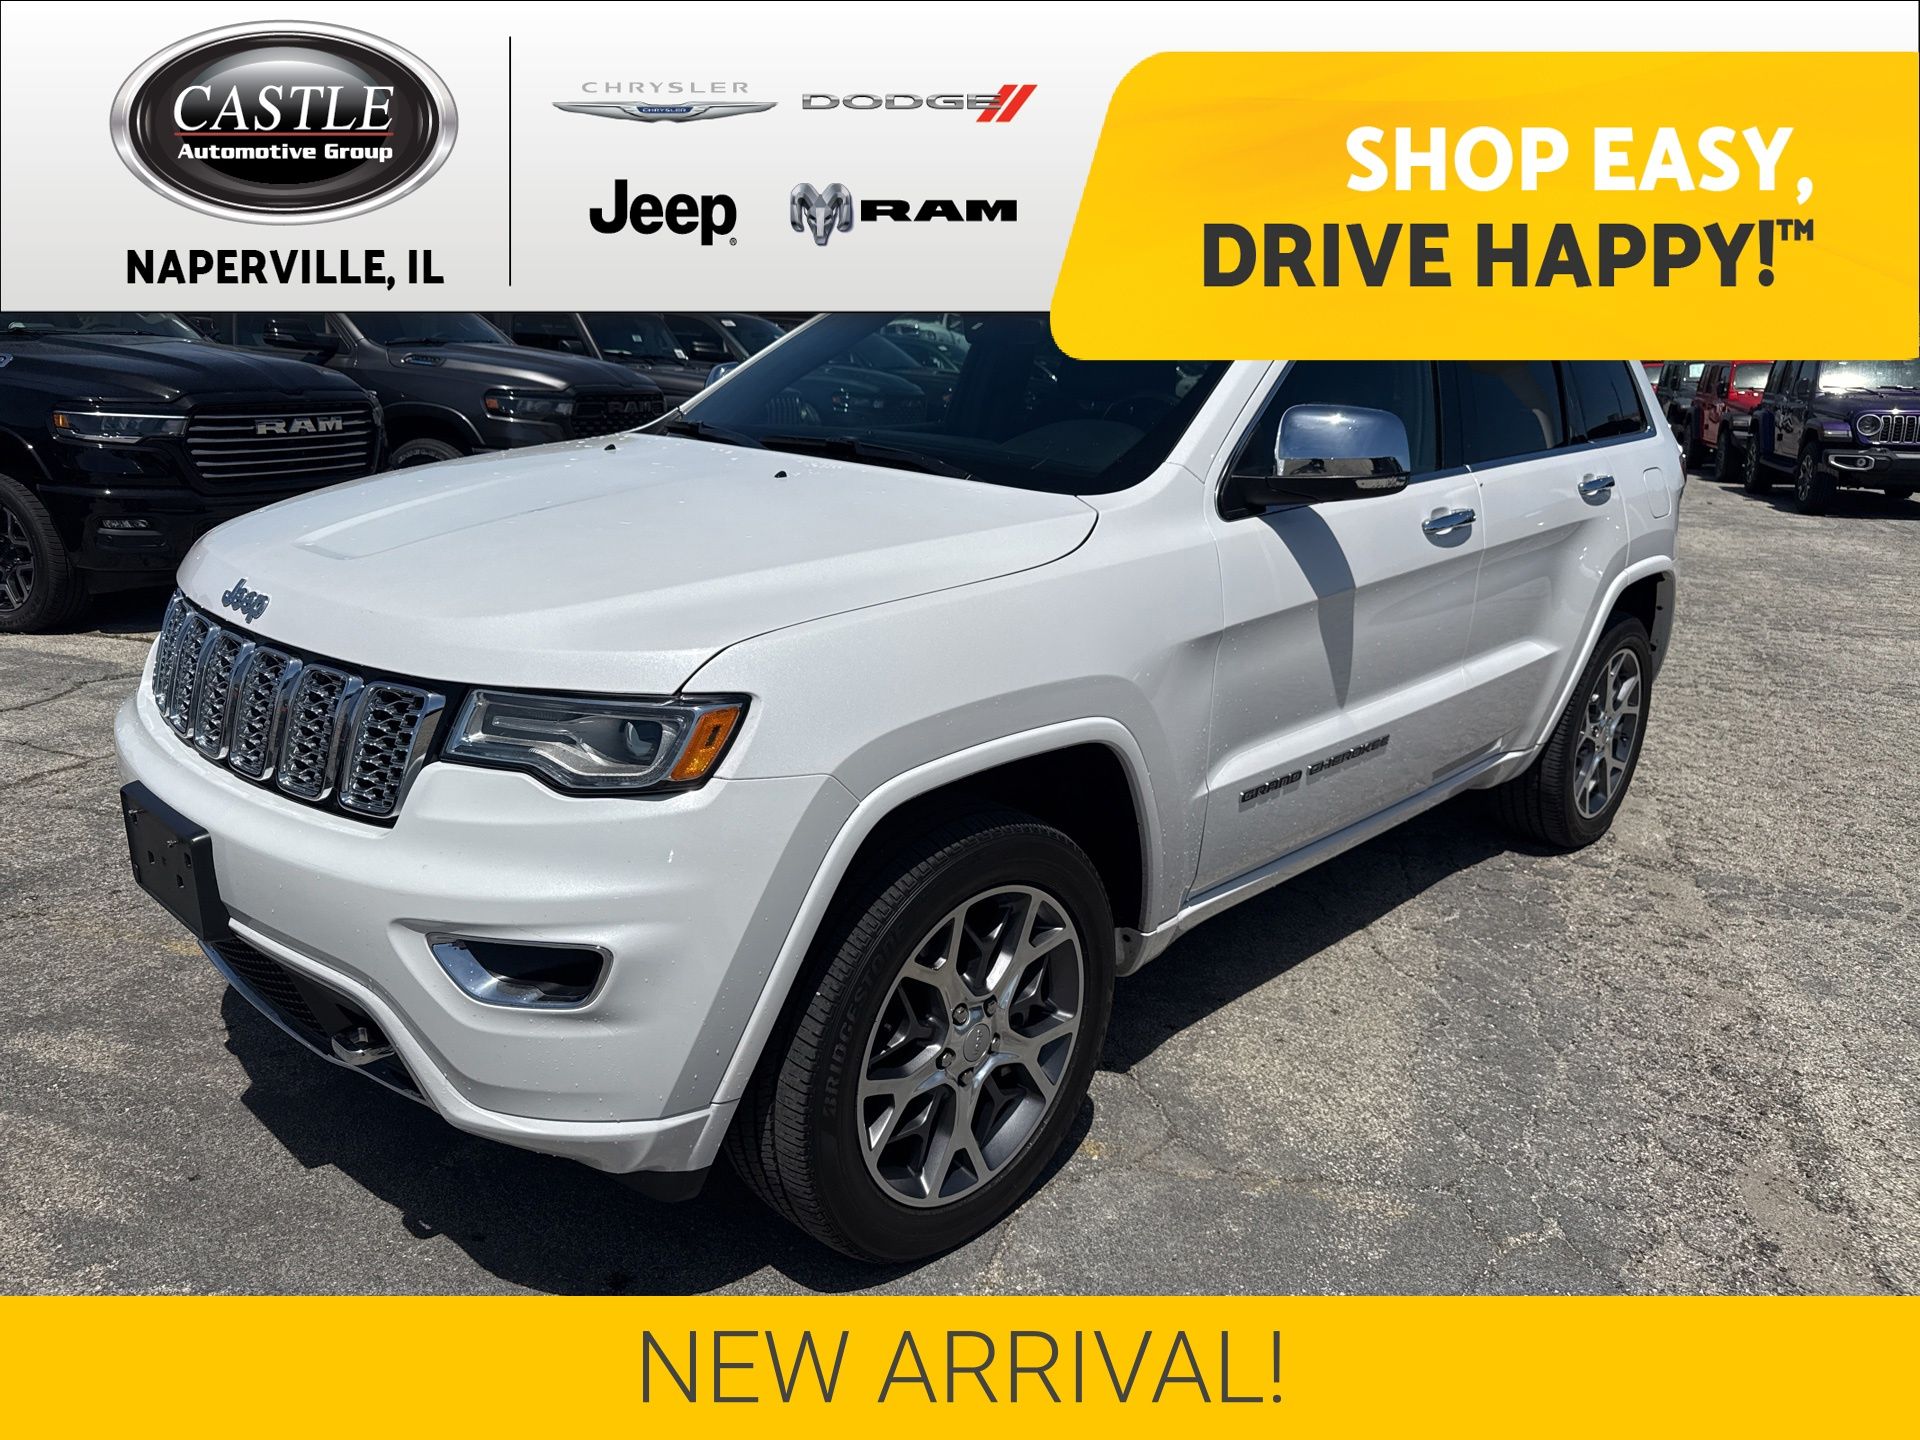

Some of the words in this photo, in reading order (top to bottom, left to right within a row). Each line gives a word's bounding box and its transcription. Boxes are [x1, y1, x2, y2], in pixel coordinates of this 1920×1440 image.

[254, 416, 344, 435] RAM
[221, 578, 270, 625] Jeep
[1238, 769, 1303, 804] GRAND
[1306, 733, 1391, 777] CHEROKEE
